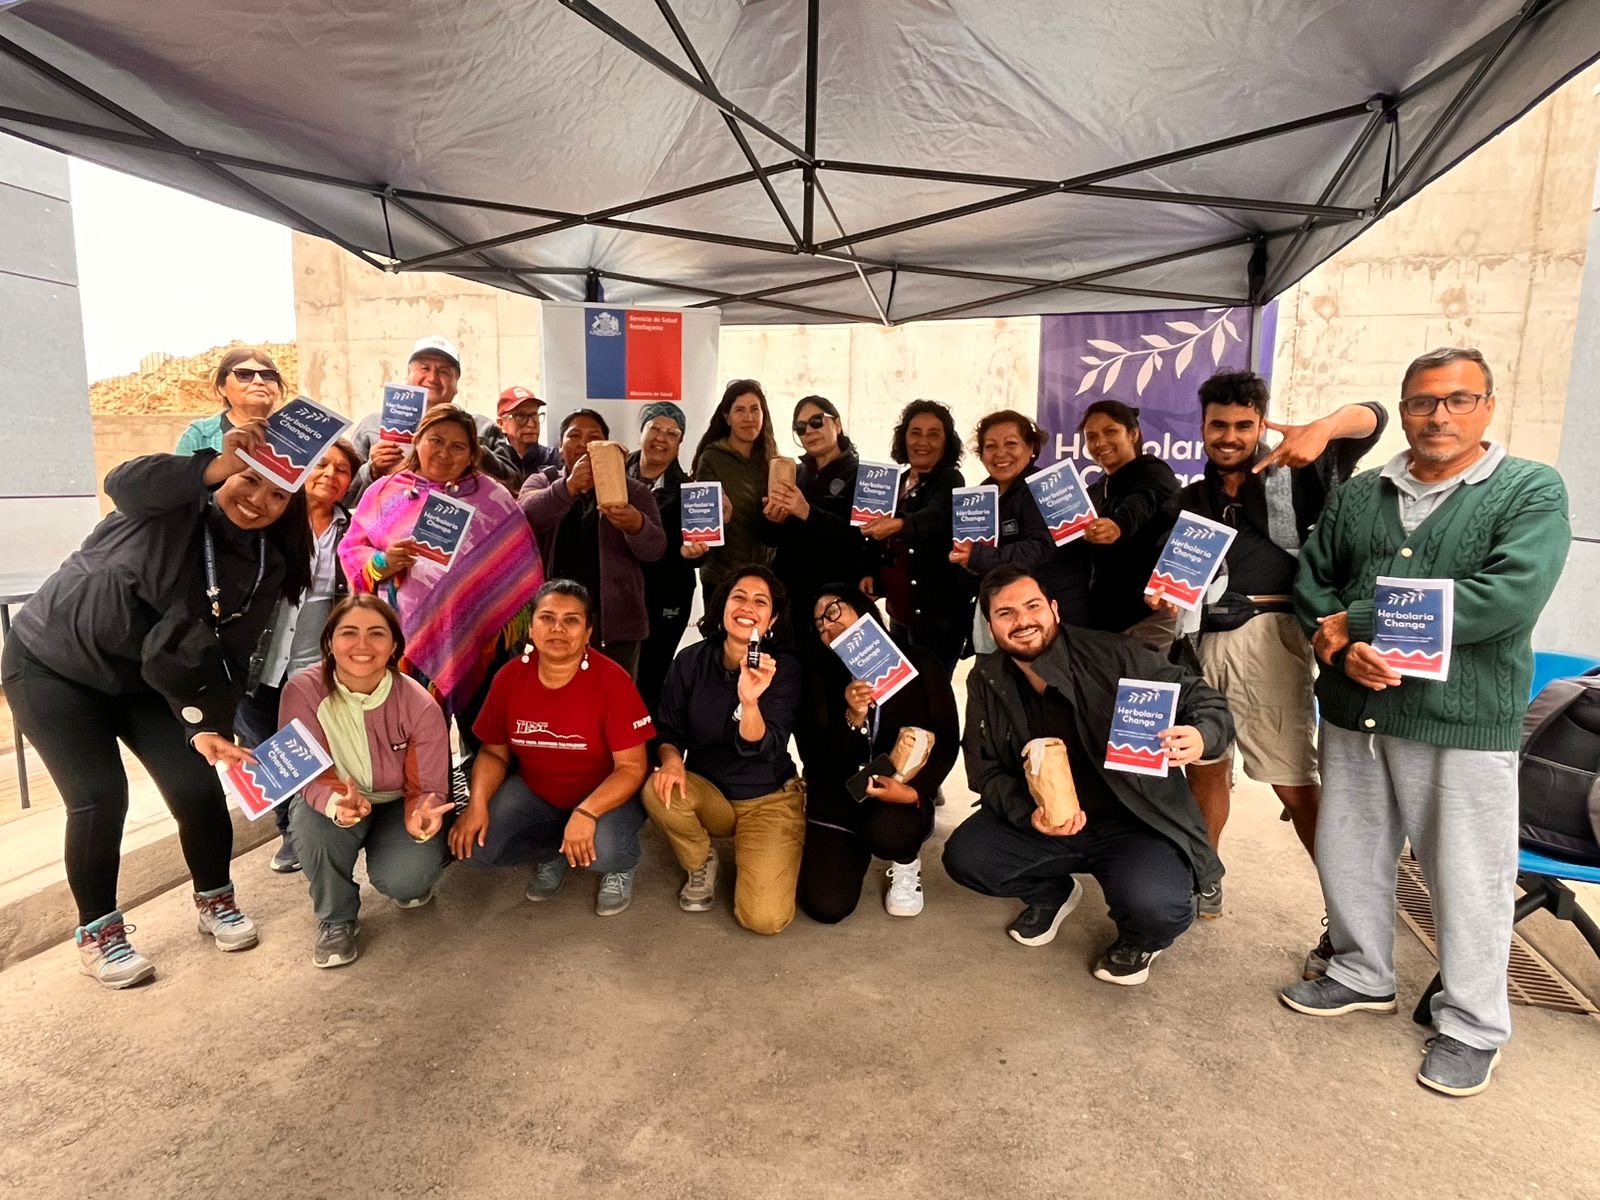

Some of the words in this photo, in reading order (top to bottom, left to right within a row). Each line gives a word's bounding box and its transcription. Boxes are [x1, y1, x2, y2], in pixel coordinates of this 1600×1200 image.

[629, 315, 652, 323] Servicio
[279, 411, 322, 439] Herbolaria
[280, 420, 310, 441] Changa
[1038, 484, 1074, 504] Herbolaria
[1171, 538, 1212, 558] Herbolaria
[1172, 547, 1202, 562] Changa
[1378, 609, 1434, 621] Herbolaria
[1384, 619, 1426, 630] Changa
[848, 639, 880, 666] Herbolaria
[857, 648, 881, 667] Changa
[1117, 706, 1164, 720] Herbolaria
[1122, 715, 1155, 727] Changa
[268, 751, 290, 778] Changa
[269, 740, 300, 778] Herbolaria
